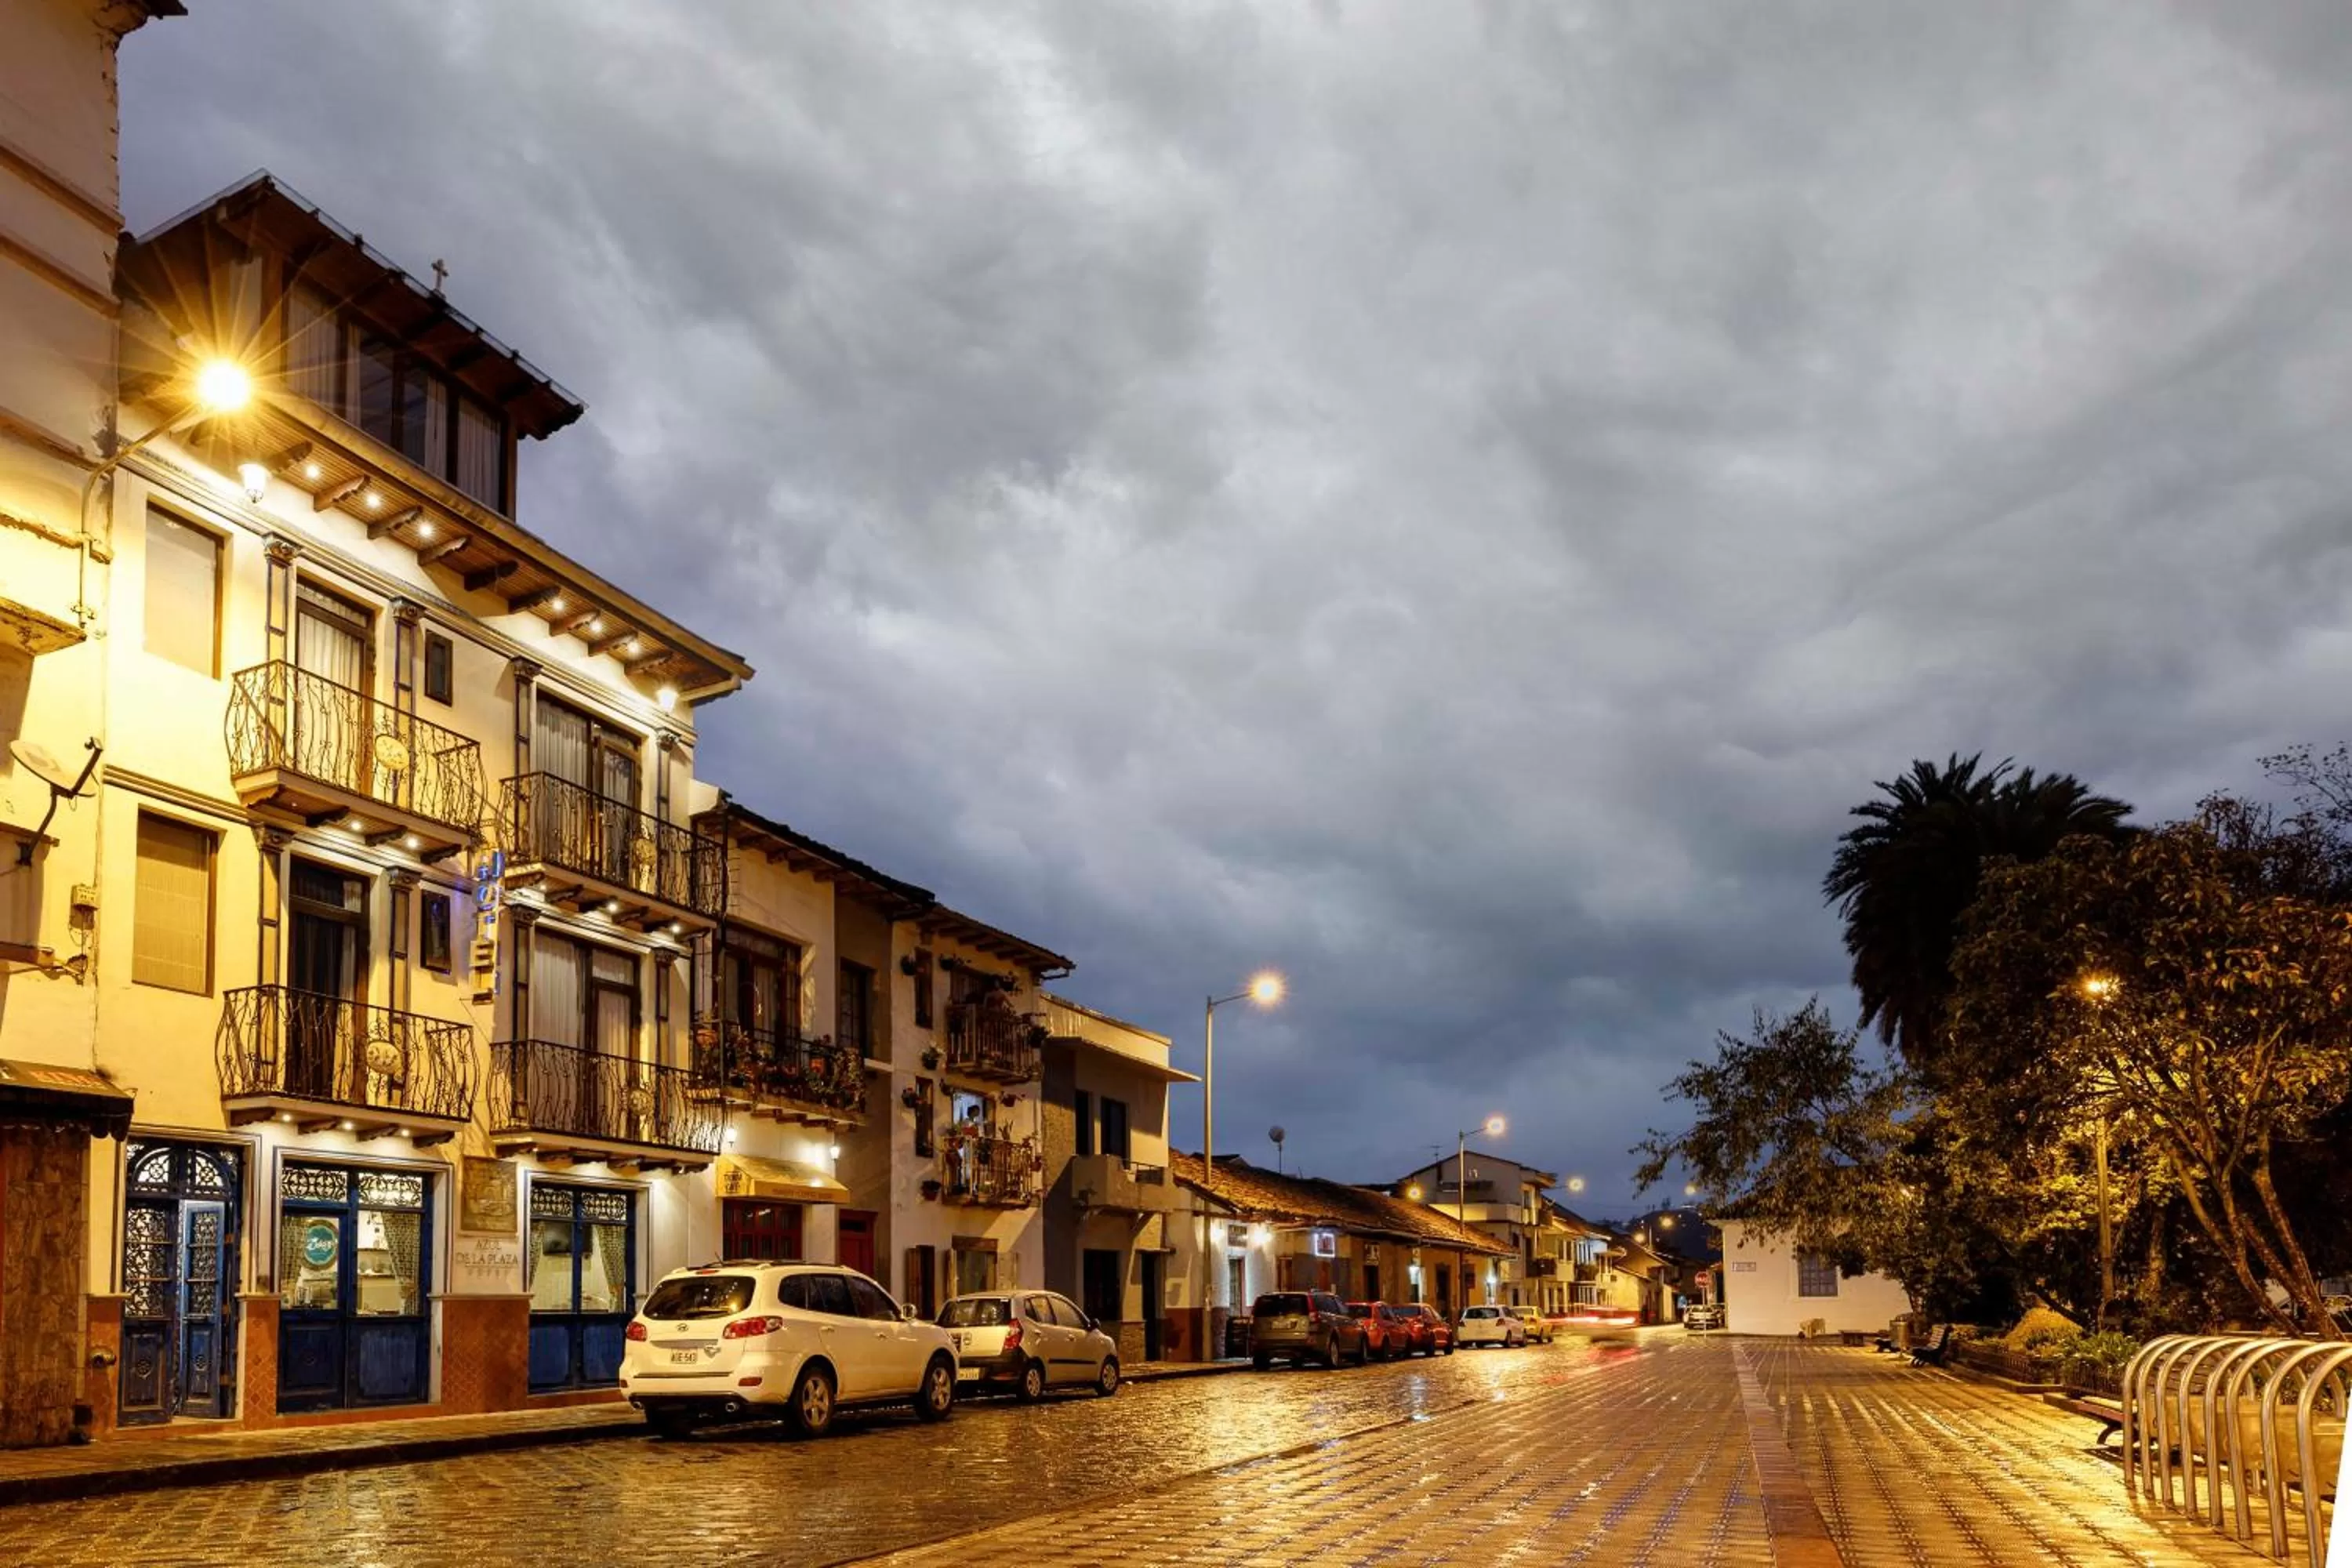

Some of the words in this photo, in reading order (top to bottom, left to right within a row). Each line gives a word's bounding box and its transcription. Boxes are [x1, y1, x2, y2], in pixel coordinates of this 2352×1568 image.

[475, 1238, 502, 1250] AZUL
[456, 1252, 470, 1265] DE
[472, 1253, 486, 1265] LA
[487, 1254, 518, 1265] PLAZA
